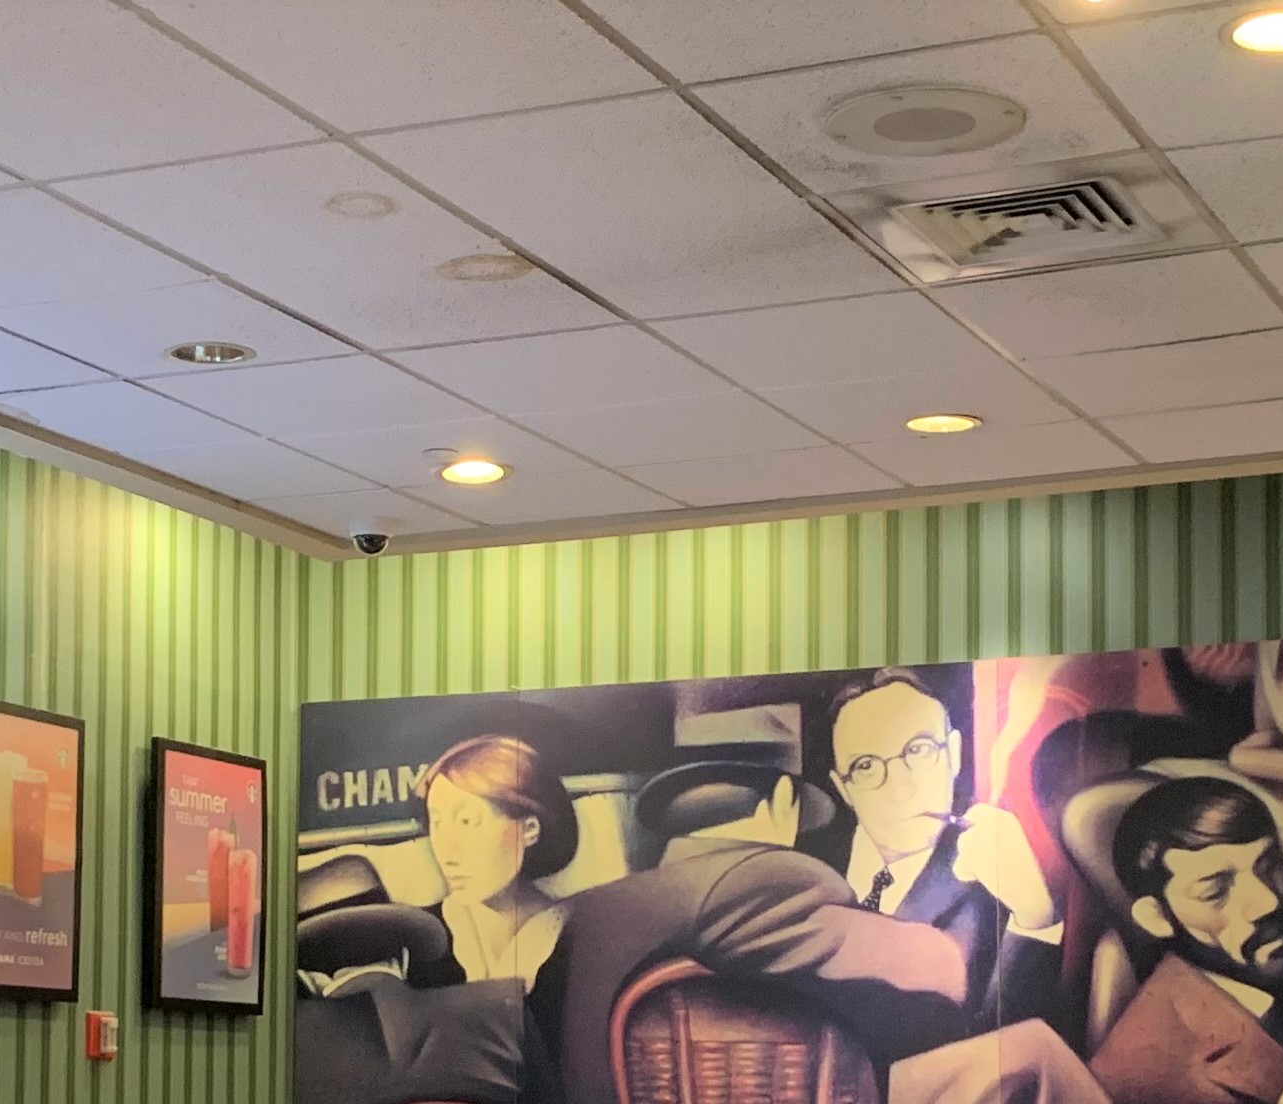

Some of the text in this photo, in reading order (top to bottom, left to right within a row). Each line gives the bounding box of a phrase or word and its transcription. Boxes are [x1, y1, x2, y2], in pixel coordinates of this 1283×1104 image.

[169, 787, 228, 814] summer
[176, 811, 209, 828] FEELING
[25, 928, 67, 946] refresh
